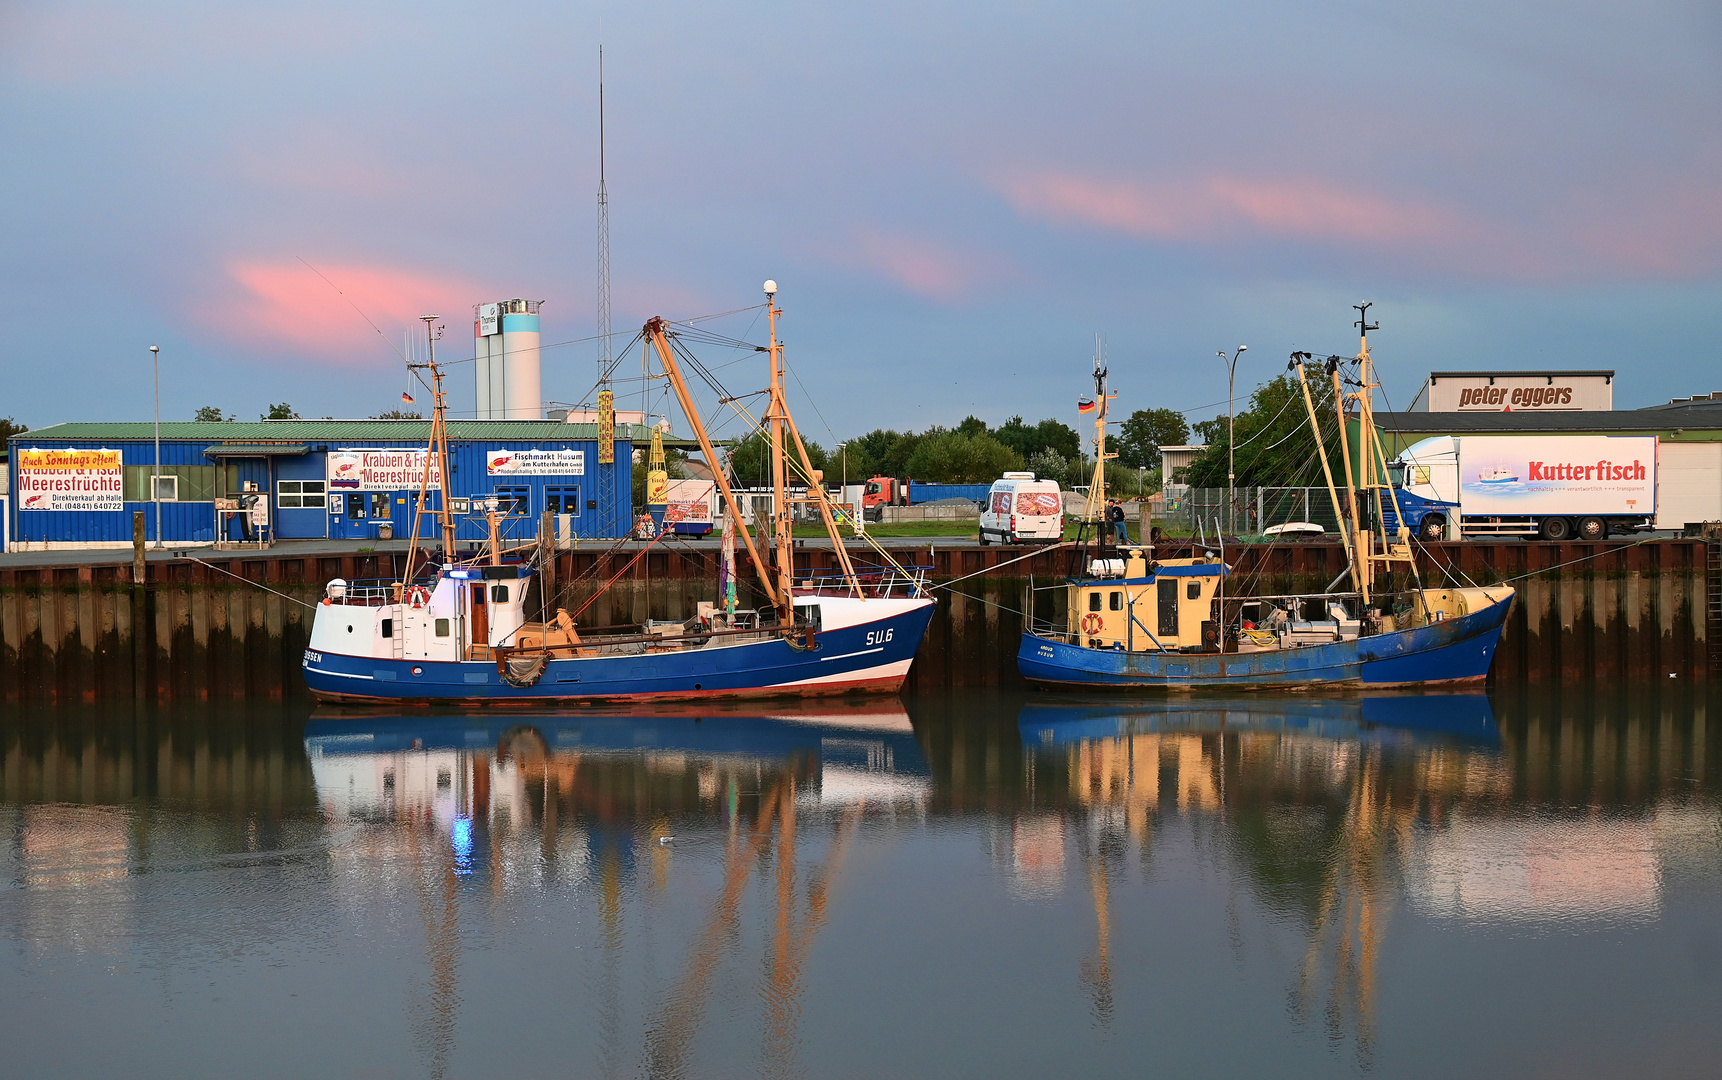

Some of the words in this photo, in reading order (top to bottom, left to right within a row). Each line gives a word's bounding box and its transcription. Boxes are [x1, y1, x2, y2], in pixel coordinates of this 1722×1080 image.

[1459, 386, 1508, 407] peter
[1511, 387, 1572, 407] eggers
[22, 456, 42, 467] Auch
[46, 454, 90, 467] Sonntags
[92, 454, 116, 466] offen!
[363, 453, 402, 467] Krabben
[405, 453, 412, 467] &
[1528, 460, 1646, 481] Kutterfisch
[19, 476, 121, 491] Meeresfrüchte
[64, 502, 92, 510] (04841)
